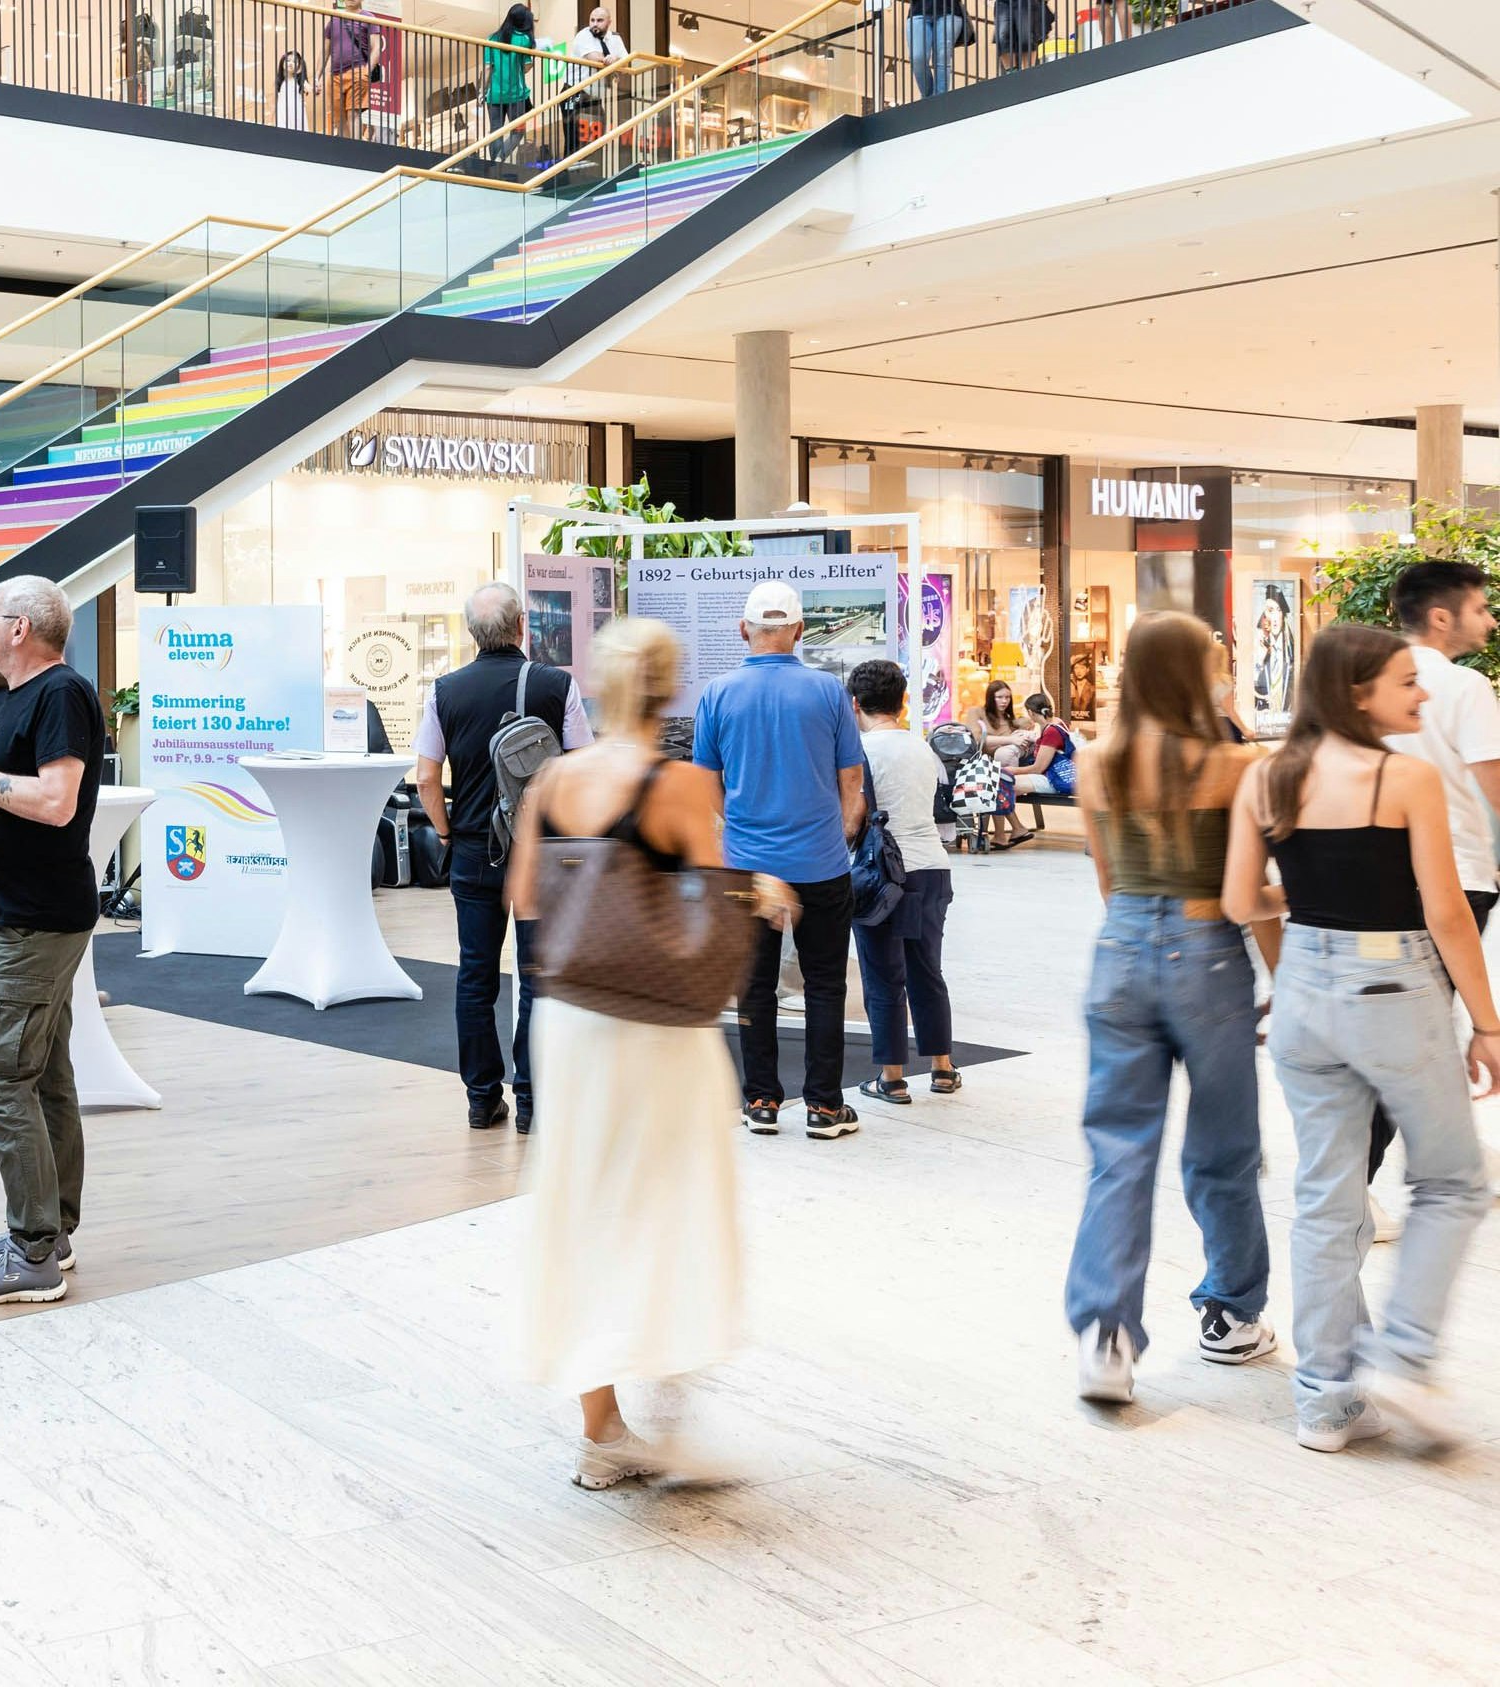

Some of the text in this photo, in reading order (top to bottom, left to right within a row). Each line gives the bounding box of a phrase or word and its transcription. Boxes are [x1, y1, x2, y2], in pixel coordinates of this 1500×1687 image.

[74, 434, 192, 463] NEVER STOP LOVING
[385, 435, 536, 475] SWAROVSKI
[1091, 477, 1205, 521] HUMANIC
[527, 563, 536, 578] Es
[537, 568, 548, 579] war
[548, 565, 568, 579] einmal
[637, 568, 672, 583] 1892
[690, 565, 785, 584] Geburtsjahr
[788, 564, 815, 579] des
[820, 562, 884, 581] „Elften“
[167, 629, 234, 648] huma
[168, 649, 215, 660] eleven
[152, 694, 246, 712] Simmering
[152, 715, 291, 732] feiert 130 Jahre!
[152, 738, 275, 752] Jubiläumsausstellung
[153, 755, 173, 764] von
[175, 754, 192, 765] Fr,
[194, 754, 215, 764] 9.9.
[169, 828, 185, 856] S
[225, 855, 288, 867] BEZIRKSMUSEU
